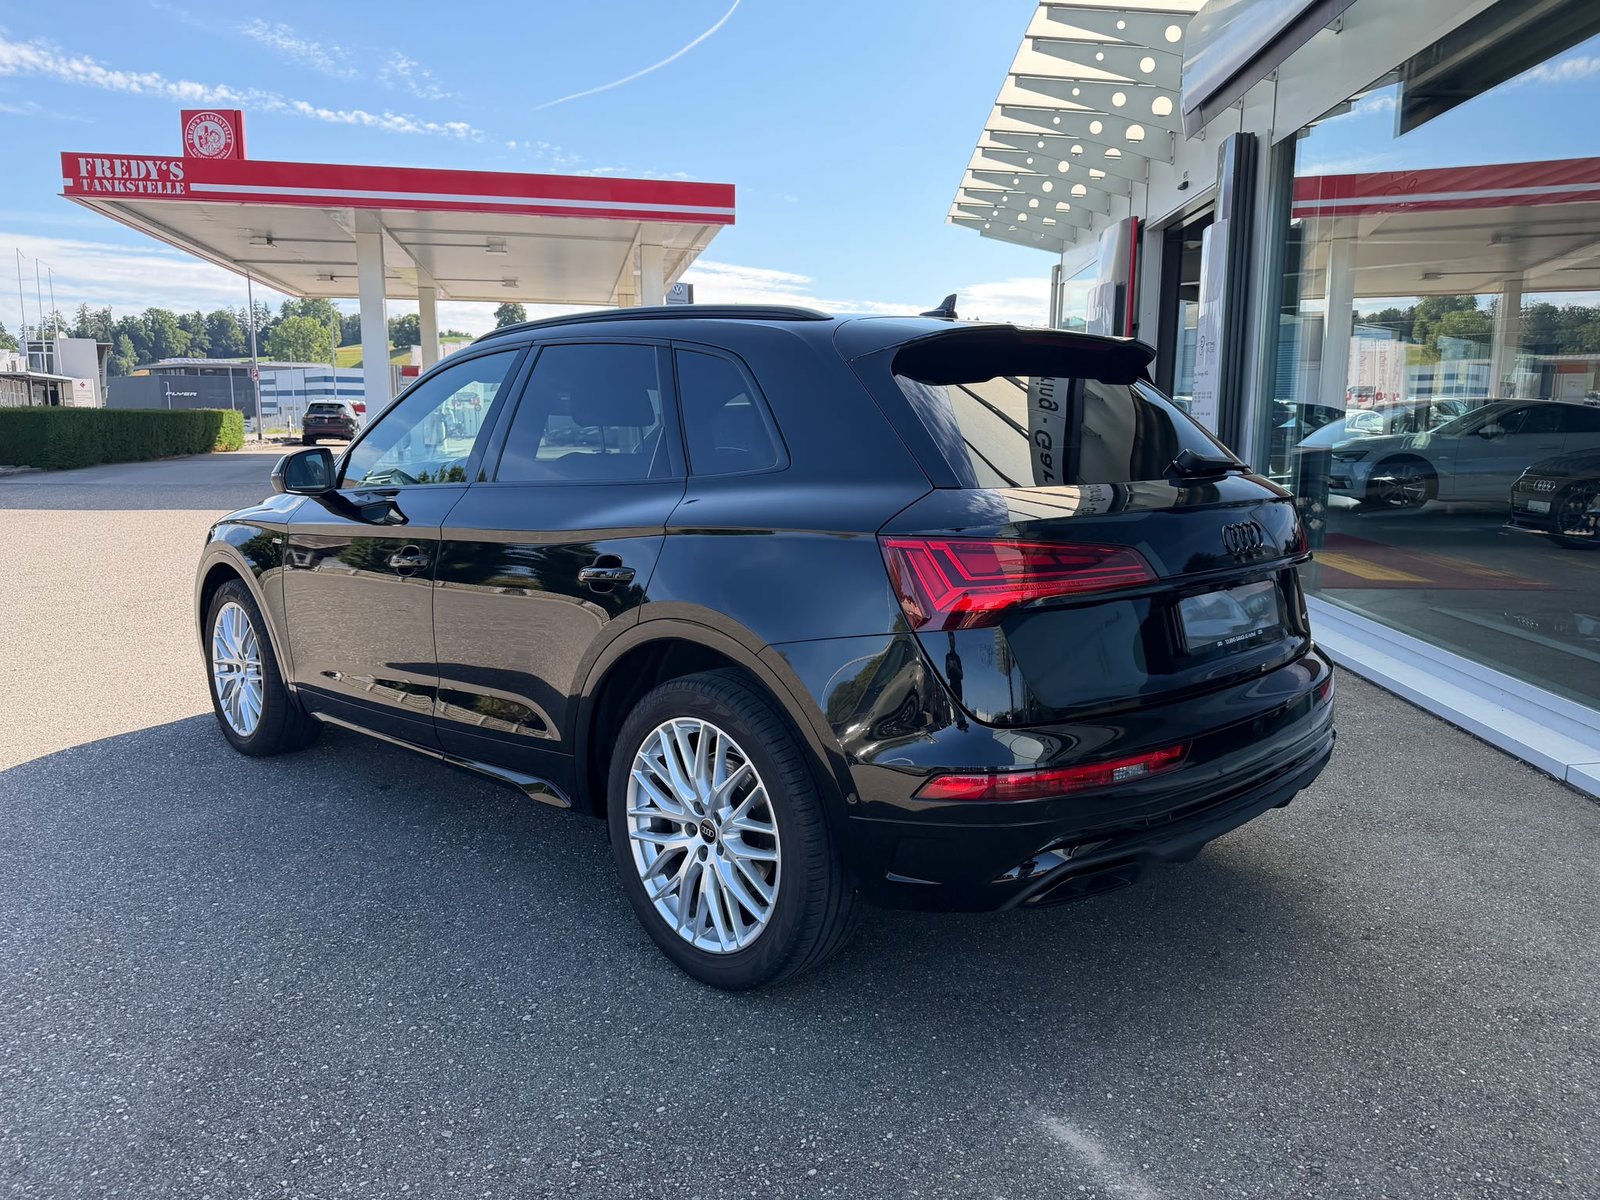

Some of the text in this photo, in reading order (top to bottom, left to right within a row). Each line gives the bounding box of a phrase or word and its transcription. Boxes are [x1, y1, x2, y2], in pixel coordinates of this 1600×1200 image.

[201, 115, 232, 144] TANKSTELLE
[79, 158, 184, 180] FREDY'S
[82, 179, 185, 195] TANKSTELLE
